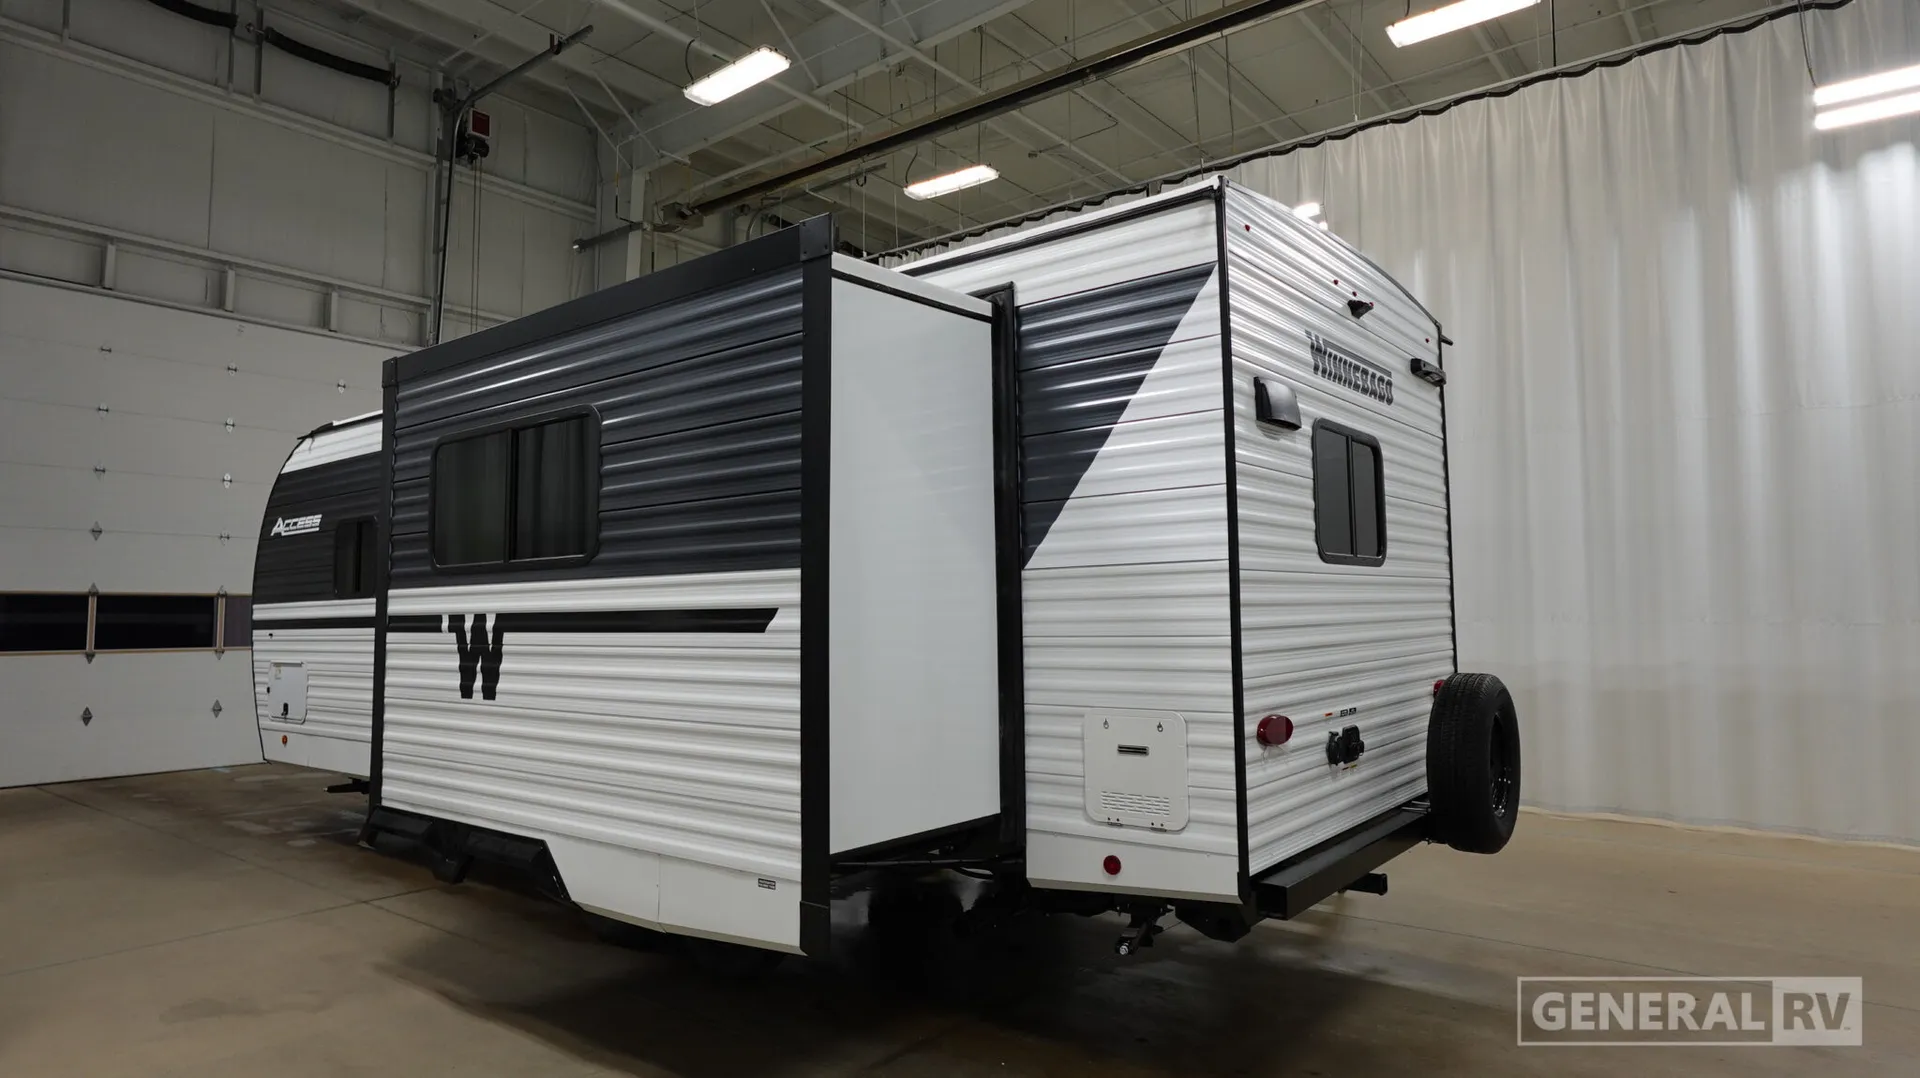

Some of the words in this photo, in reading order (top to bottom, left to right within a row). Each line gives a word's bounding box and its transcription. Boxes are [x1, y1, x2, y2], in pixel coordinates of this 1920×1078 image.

[1306, 330, 1394, 406] WINNEBAGO
[270, 514, 322, 536] ACCESS
[448, 613, 505, 700] W
